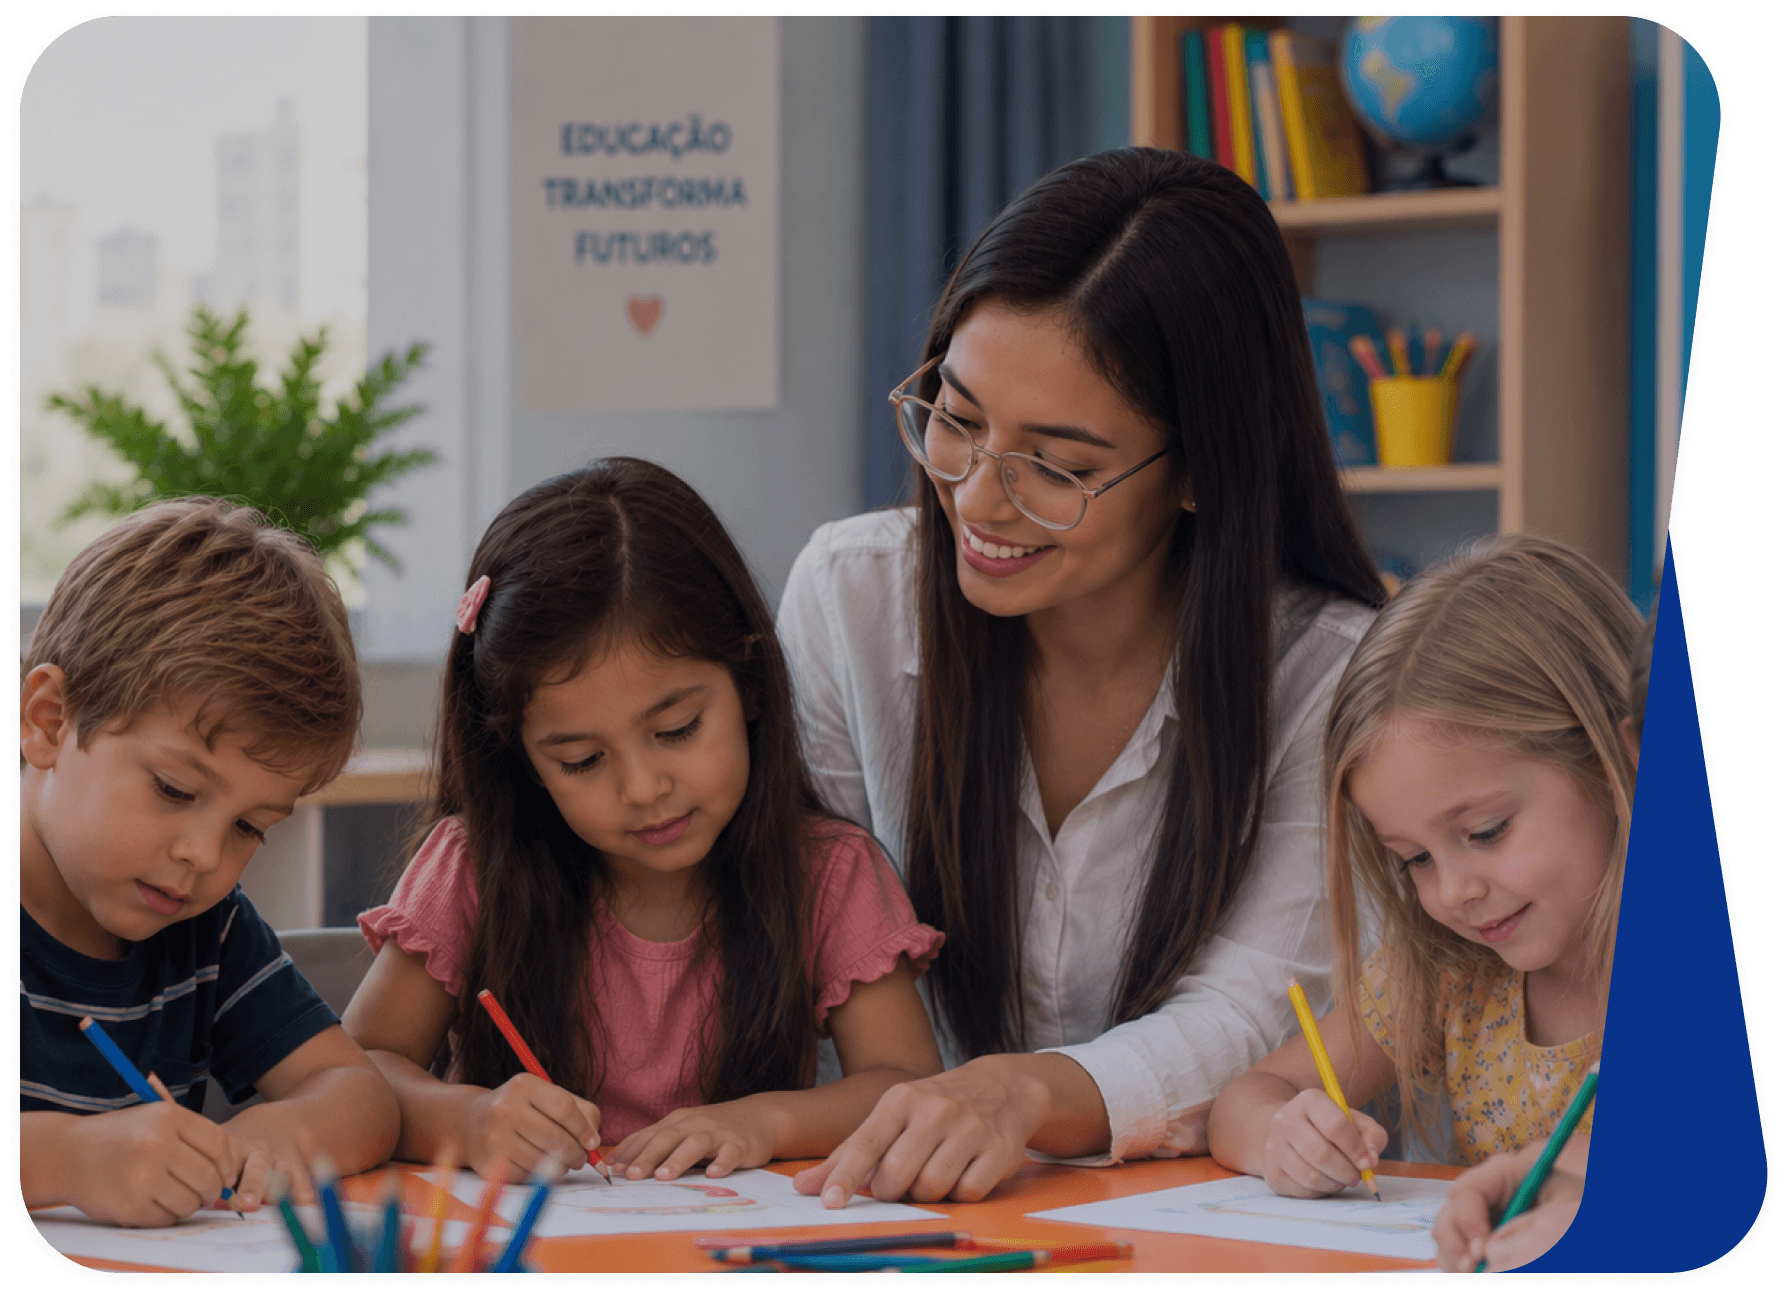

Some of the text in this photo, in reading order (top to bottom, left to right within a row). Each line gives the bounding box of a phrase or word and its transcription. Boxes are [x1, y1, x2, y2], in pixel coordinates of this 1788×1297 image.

[560, 114, 731, 162] EDUCAÇÃO
[543, 176, 748, 210] TRANSFORMA
[574, 230, 717, 265] FUTUROS
